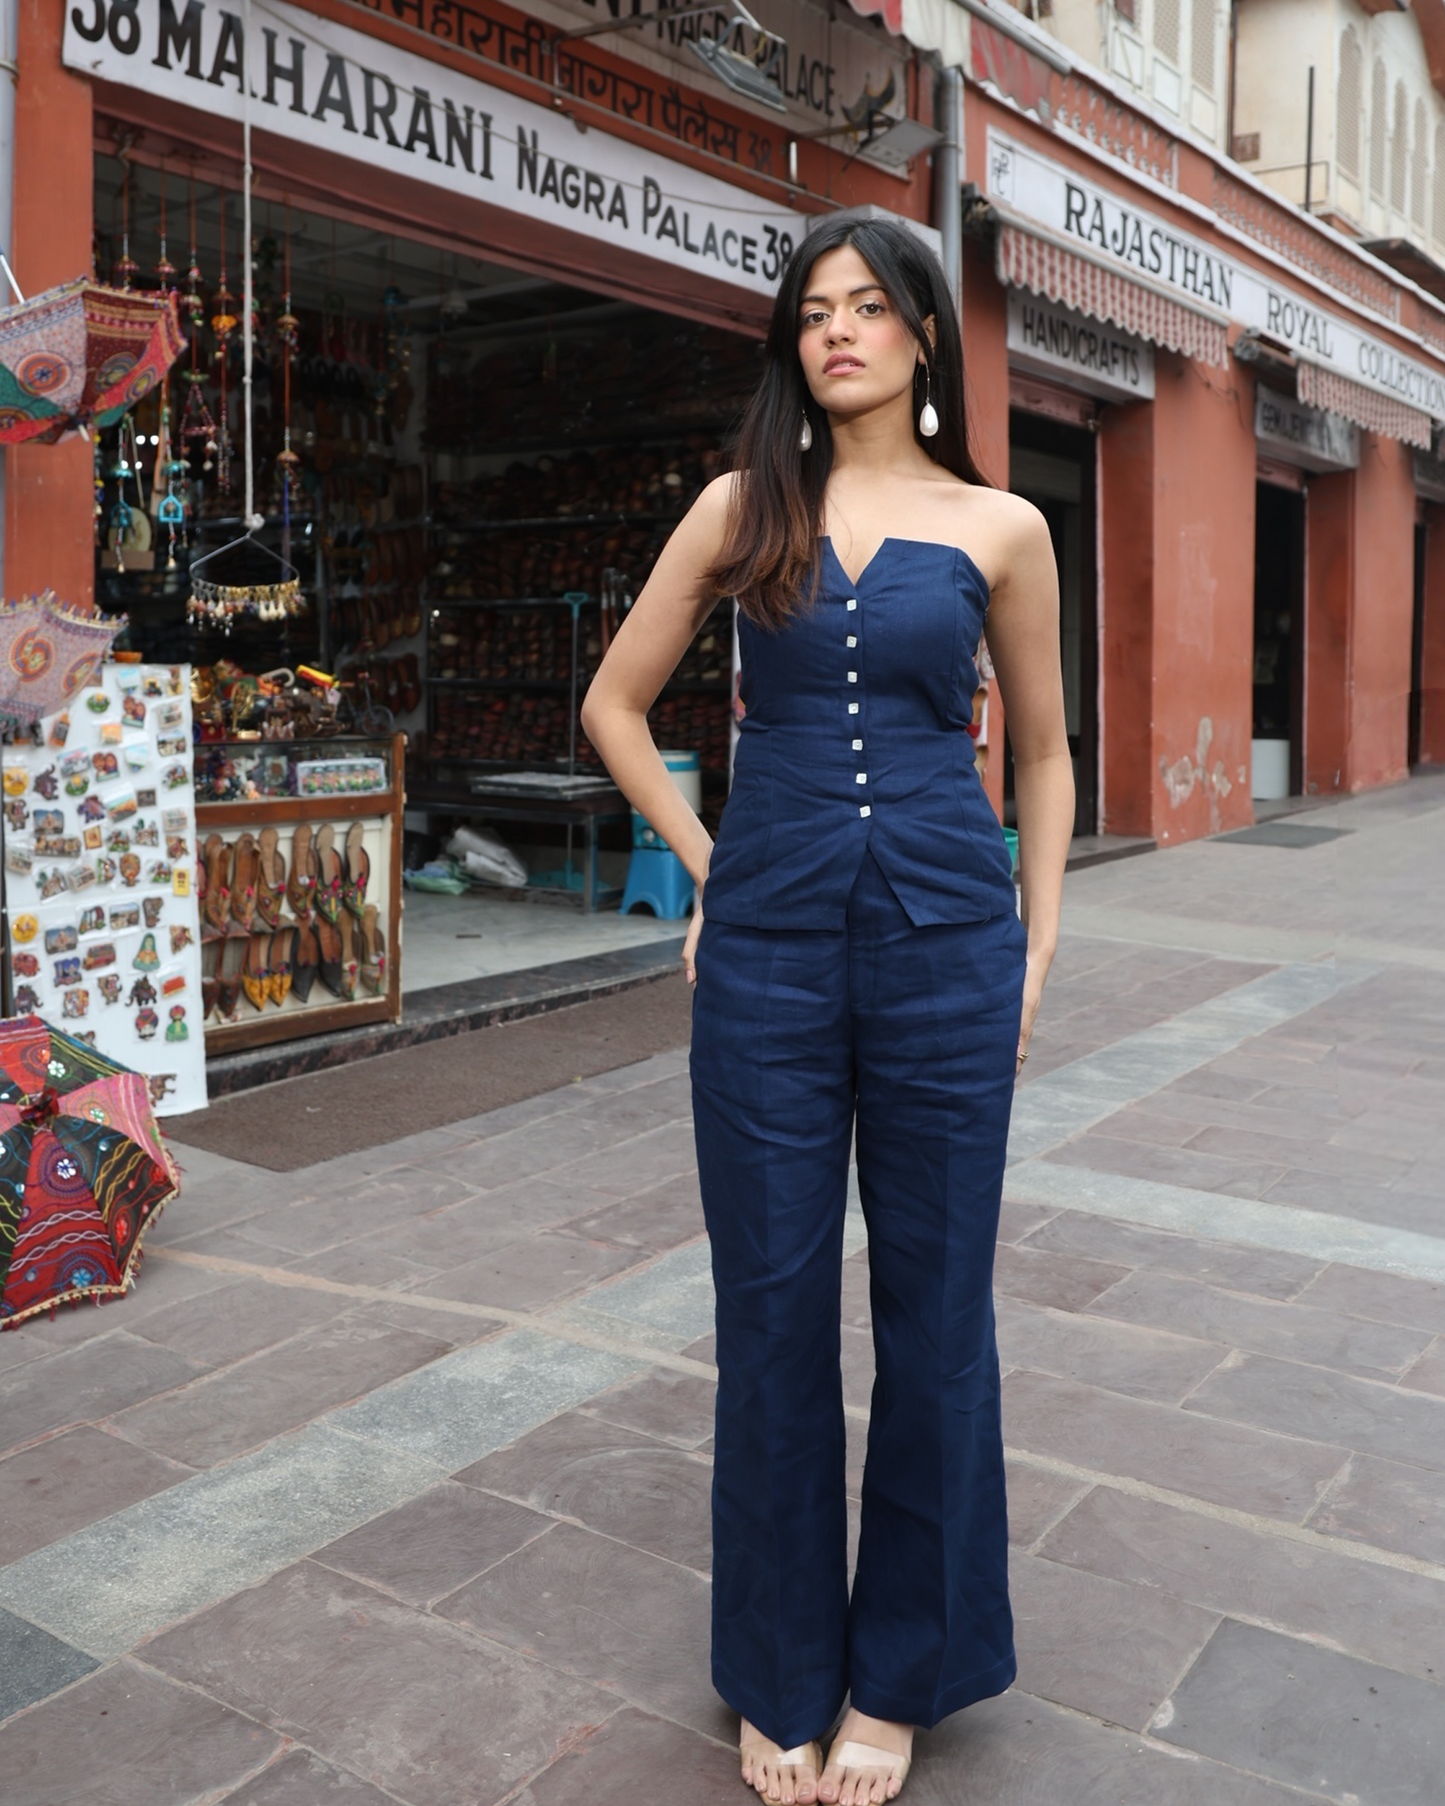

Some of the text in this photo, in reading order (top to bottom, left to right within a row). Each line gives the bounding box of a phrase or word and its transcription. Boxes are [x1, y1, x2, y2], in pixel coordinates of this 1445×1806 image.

[152, 0, 494, 180] MAHARANI
[516, 124, 628, 230] NAGRA
[642, 174, 758, 276] PALACE
[1022, 304, 1140, 386] HANDICRAFTS
[1064, 180, 1233, 310] RAJASTHAN
[1267, 290, 1334, 359] ROYAL
